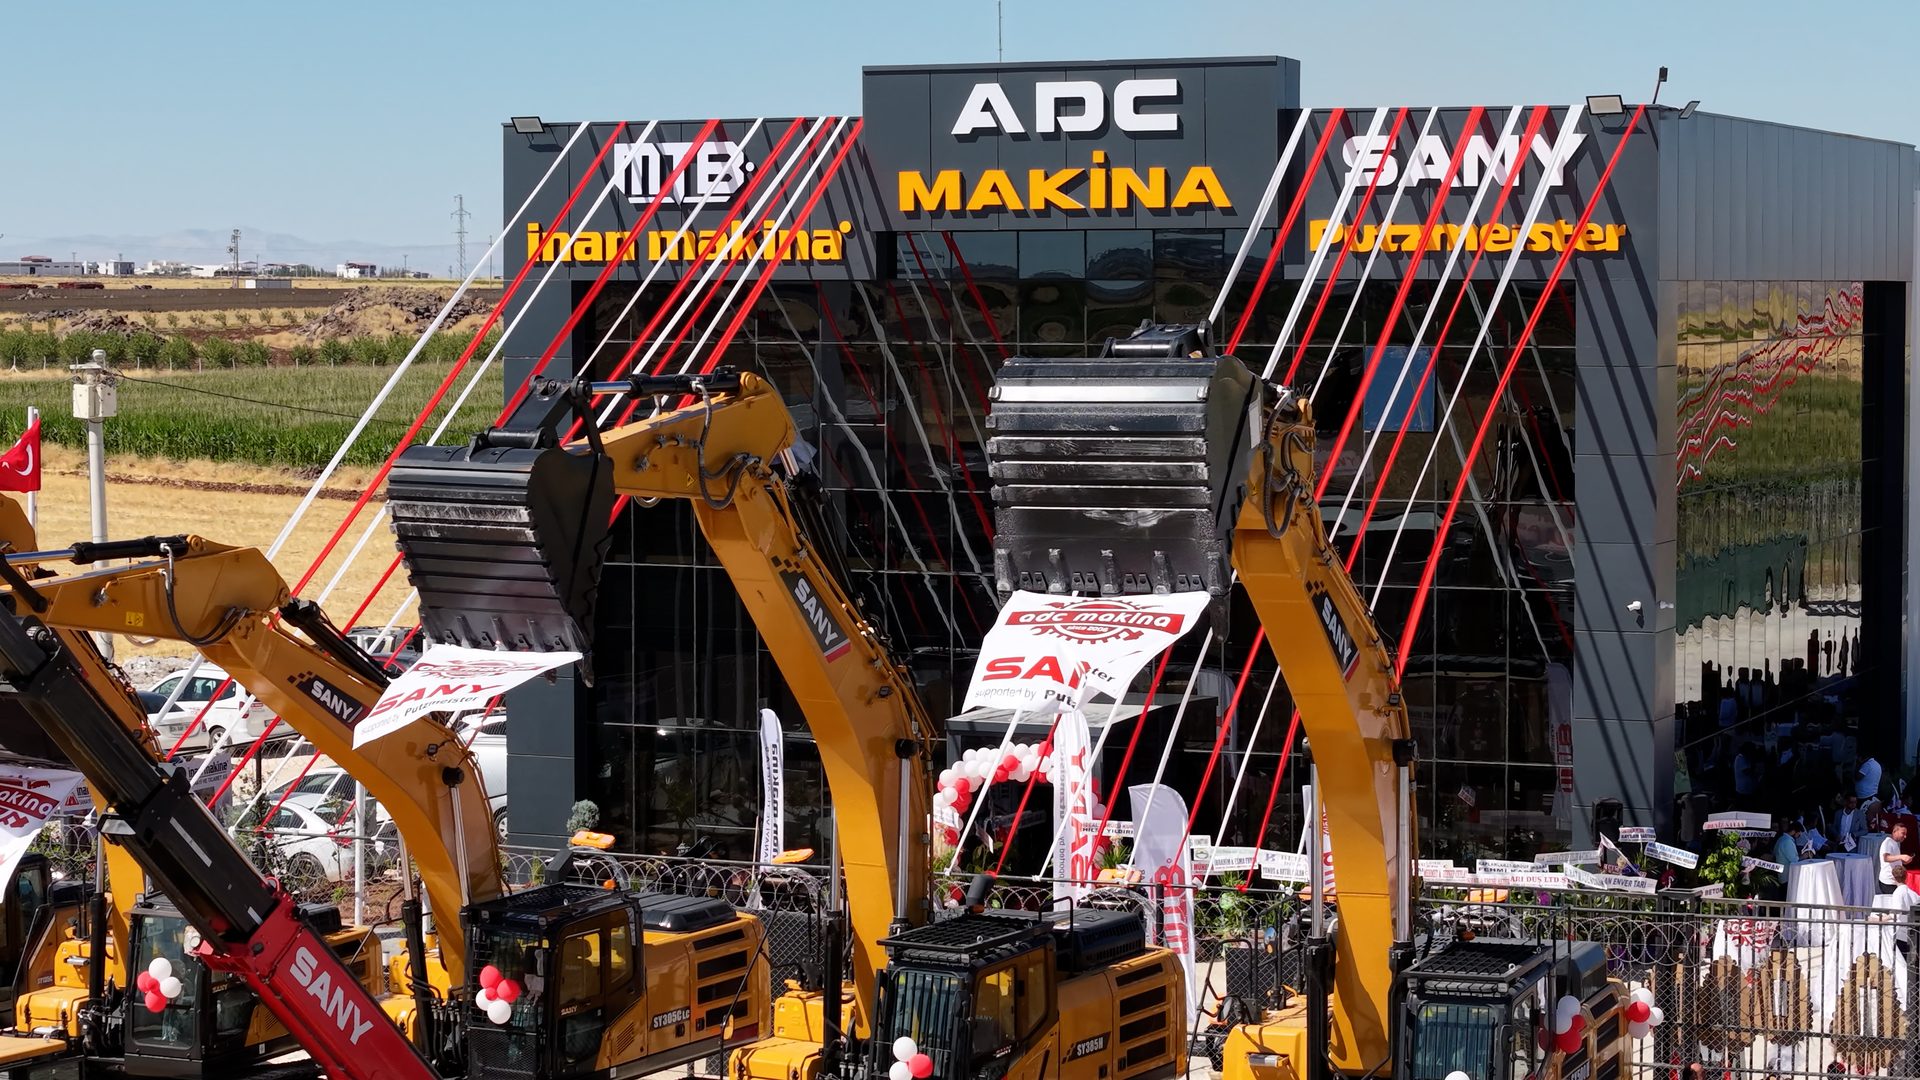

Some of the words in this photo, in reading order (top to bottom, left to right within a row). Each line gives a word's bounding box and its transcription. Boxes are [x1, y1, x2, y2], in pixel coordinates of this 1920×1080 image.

[951, 79, 1178, 135] ADC
[613, 141, 747, 206] MTB
[898, 150, 1233, 212] MAKİNA
[1342, 133, 1588, 189] SANY
[526, 222, 636, 263] inan
[647, 219, 845, 263] makina
[1309, 219, 1627, 253] Putzmeister
[794, 577, 839, 646] SANY
[1018, 611, 1068, 624] adc
[1073, 611, 1172, 628] makina
[1321, 596, 1352, 665] SANY
[310, 680, 354, 720] SANY
[368, 684, 503, 719] SANY
[404, 695, 479, 717] Putzmeister
[289, 946, 375, 1046] SANY
